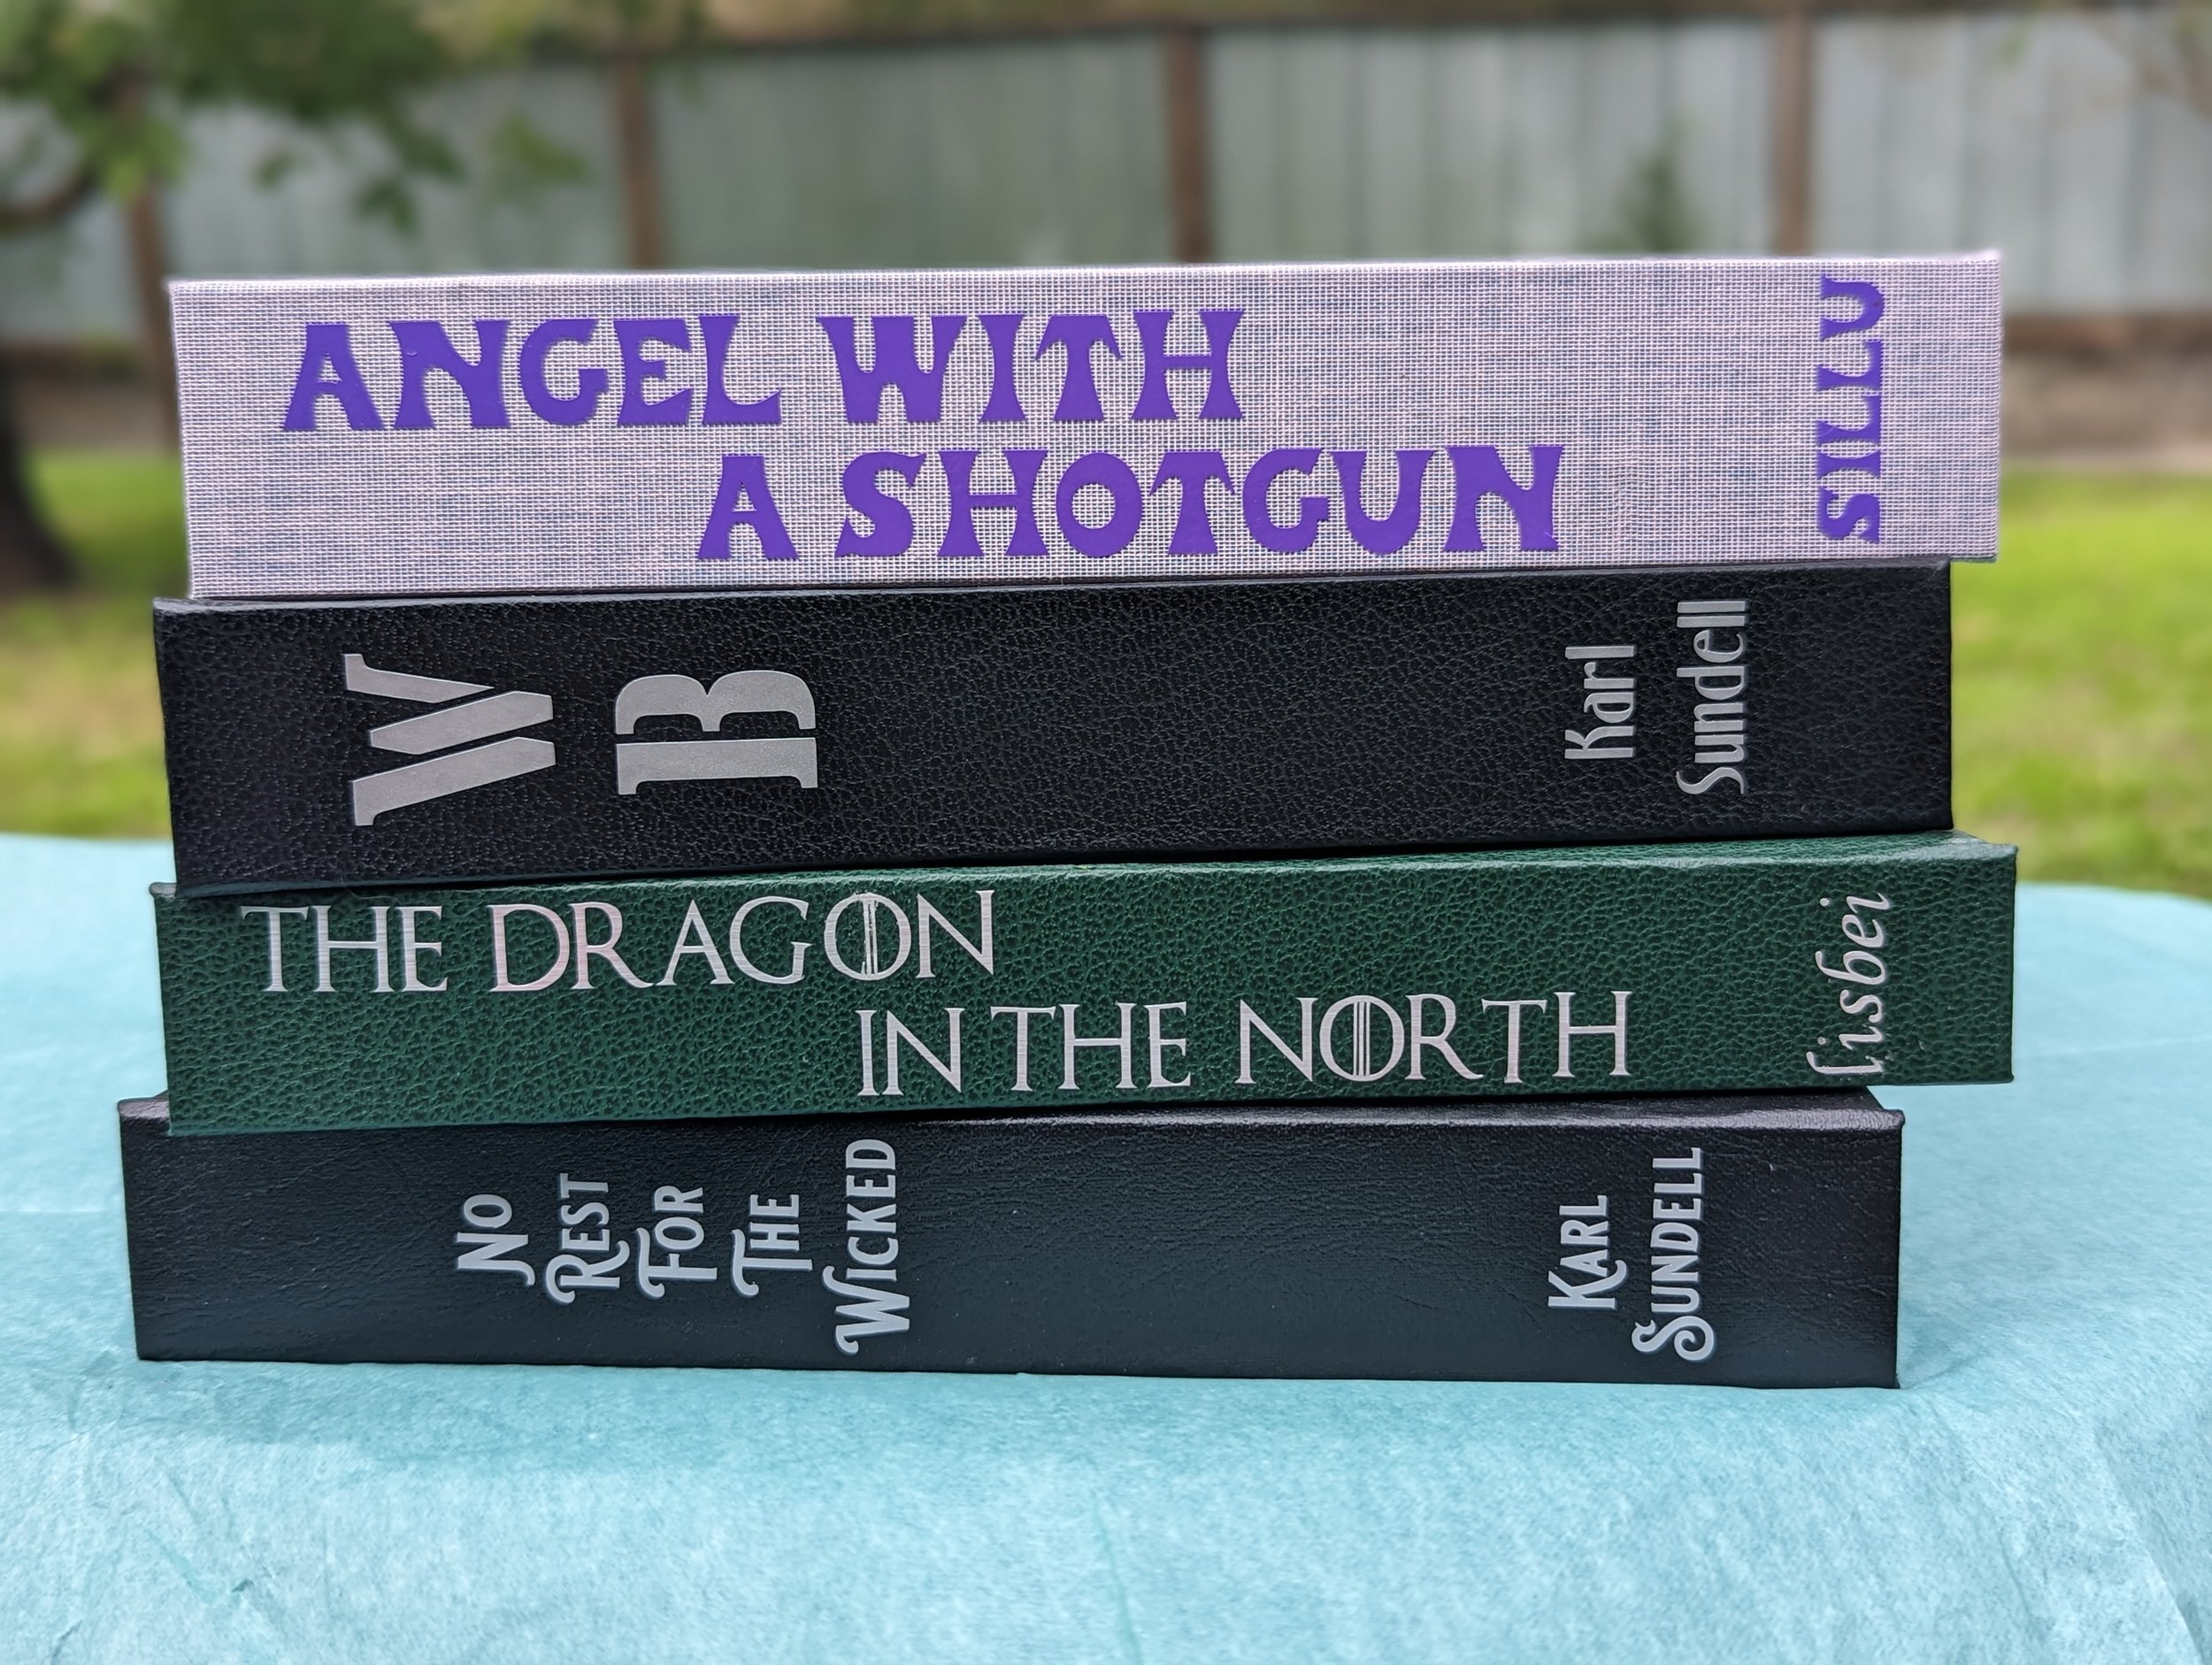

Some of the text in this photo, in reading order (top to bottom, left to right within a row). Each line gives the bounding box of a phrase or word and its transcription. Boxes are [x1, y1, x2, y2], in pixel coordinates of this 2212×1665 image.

[282, 310, 1245, 431] ANGEL WITH
[1814, 272, 1885, 543] SILLU
[696, 444, 1561, 561] A SHOTGUN
[344, 654, 556, 826] W
[614, 670, 818, 795] B
[1564, 645, 1635, 759] Karl
[1677, 600, 1746, 795] Sundell
[242, 890, 995, 993] THE DRAGON
[855, 991, 1632, 1097] IN THE NORTH
[456, 1193, 534, 1286] NO
[544, 1173, 630, 1306] REST
[636, 1185, 718, 1302] FOR
[730, 1193, 813, 1298] THE
[822, 1139, 910, 1356] WICKED
[1548, 1194, 1627, 1309] KARL
[1631, 1147, 1715, 1362] SUNDELL
